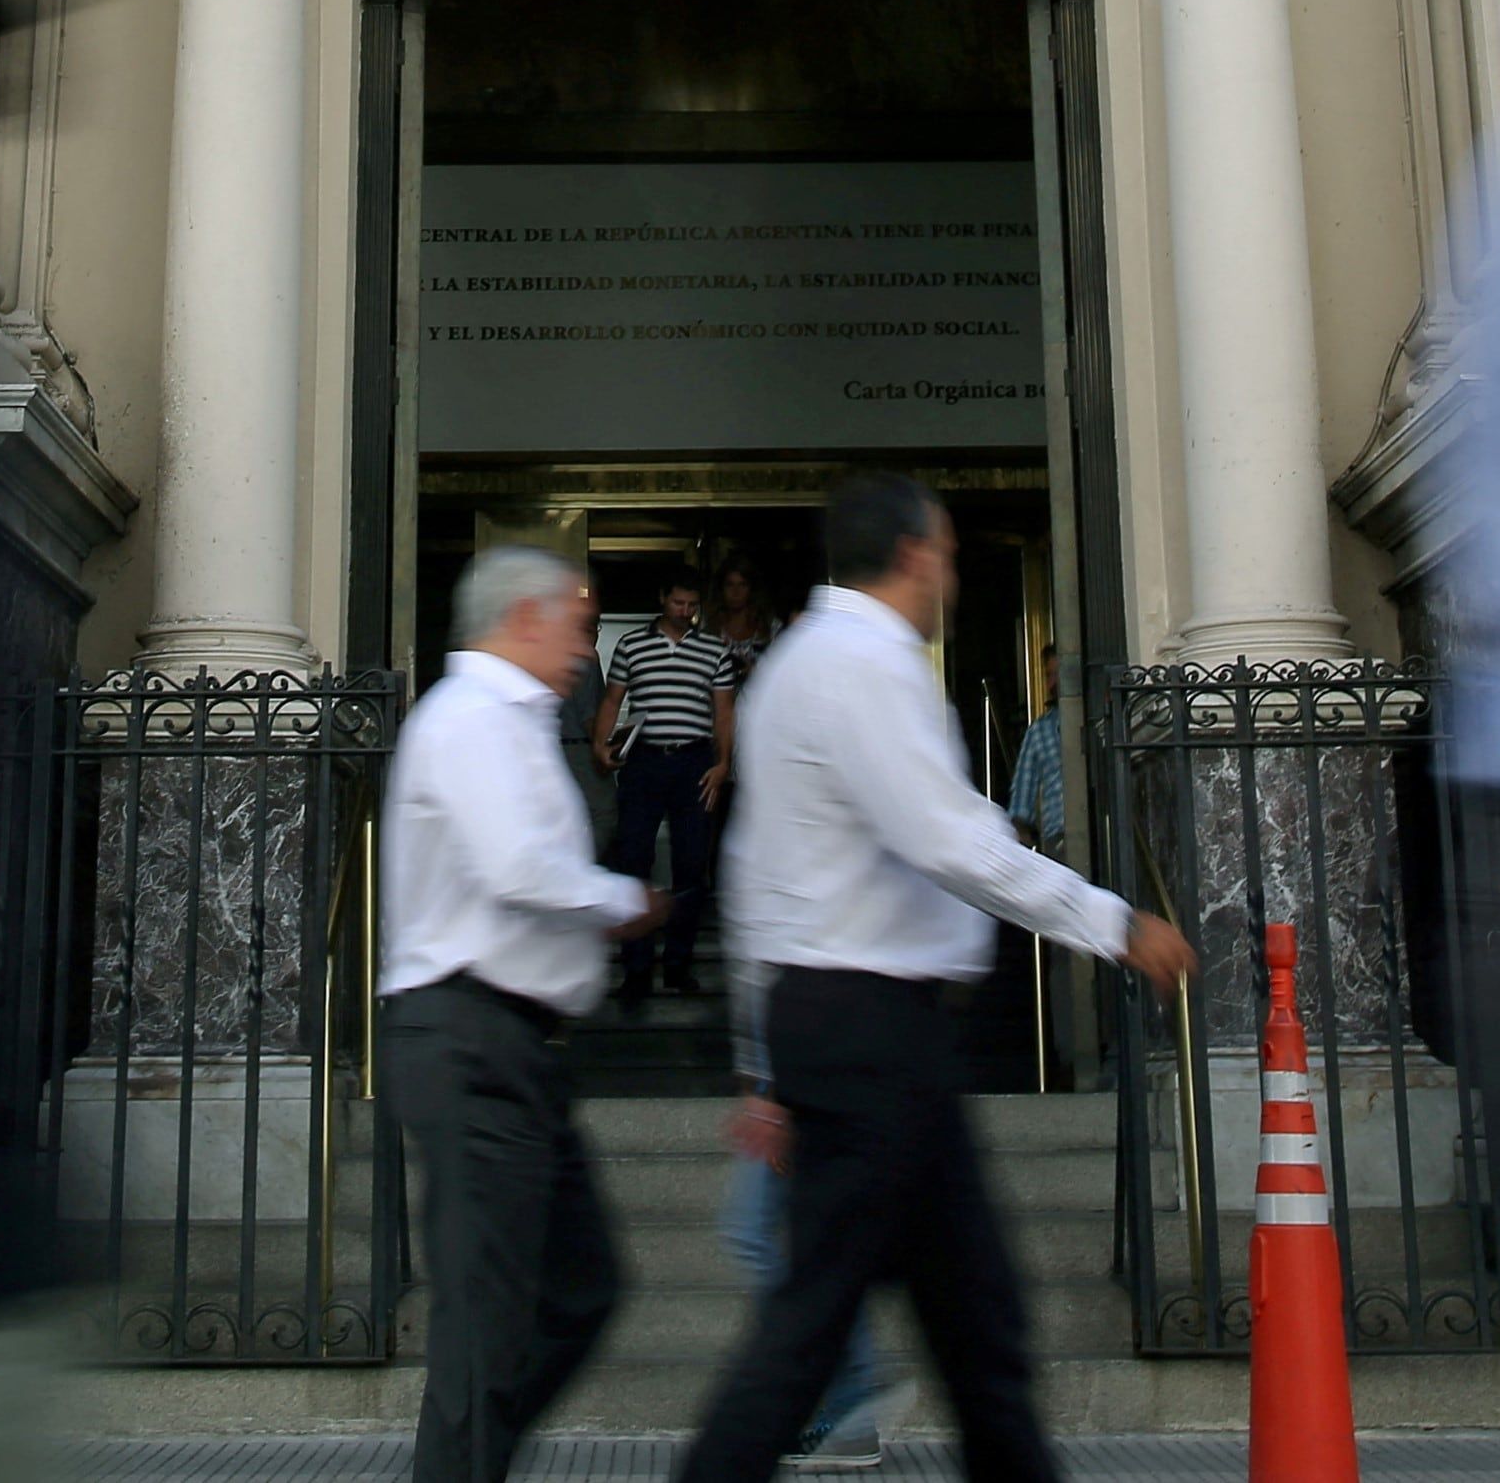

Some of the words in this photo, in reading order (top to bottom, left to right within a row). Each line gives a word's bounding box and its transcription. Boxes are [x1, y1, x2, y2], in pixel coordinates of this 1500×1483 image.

[421, 228, 517, 242] CENTRAL
[524, 228, 552, 242] DE
[560, 228, 589, 242] LA
[596, 223, 717, 241] REPÚBLICA
[725, 225, 852, 239] ARGENTINA
[860, 224, 924, 239] TIENE
[932, 223, 975, 238] POR
[432, 278, 460, 291] LA
[467, 277, 613, 291] ESTABILIDAD
[620, 275, 758, 292] MONETARIA,
[765, 274, 792, 288] LA
[800, 273, 946, 287] ESTABILIDAD
[429, 326, 442, 341] Y
[448, 326, 474, 341] EL
[481, 325, 625, 340] DESARROLLO
[632, 320, 766, 339] ECONÓMICO
[774, 323, 818, 338] CON
[827, 322, 926, 339] EQUIDAD
[934, 321, 1019, 336] SOCIAL.
[843, 381, 906, 400] Carta
[914, 379, 1016, 405] Orgánica
